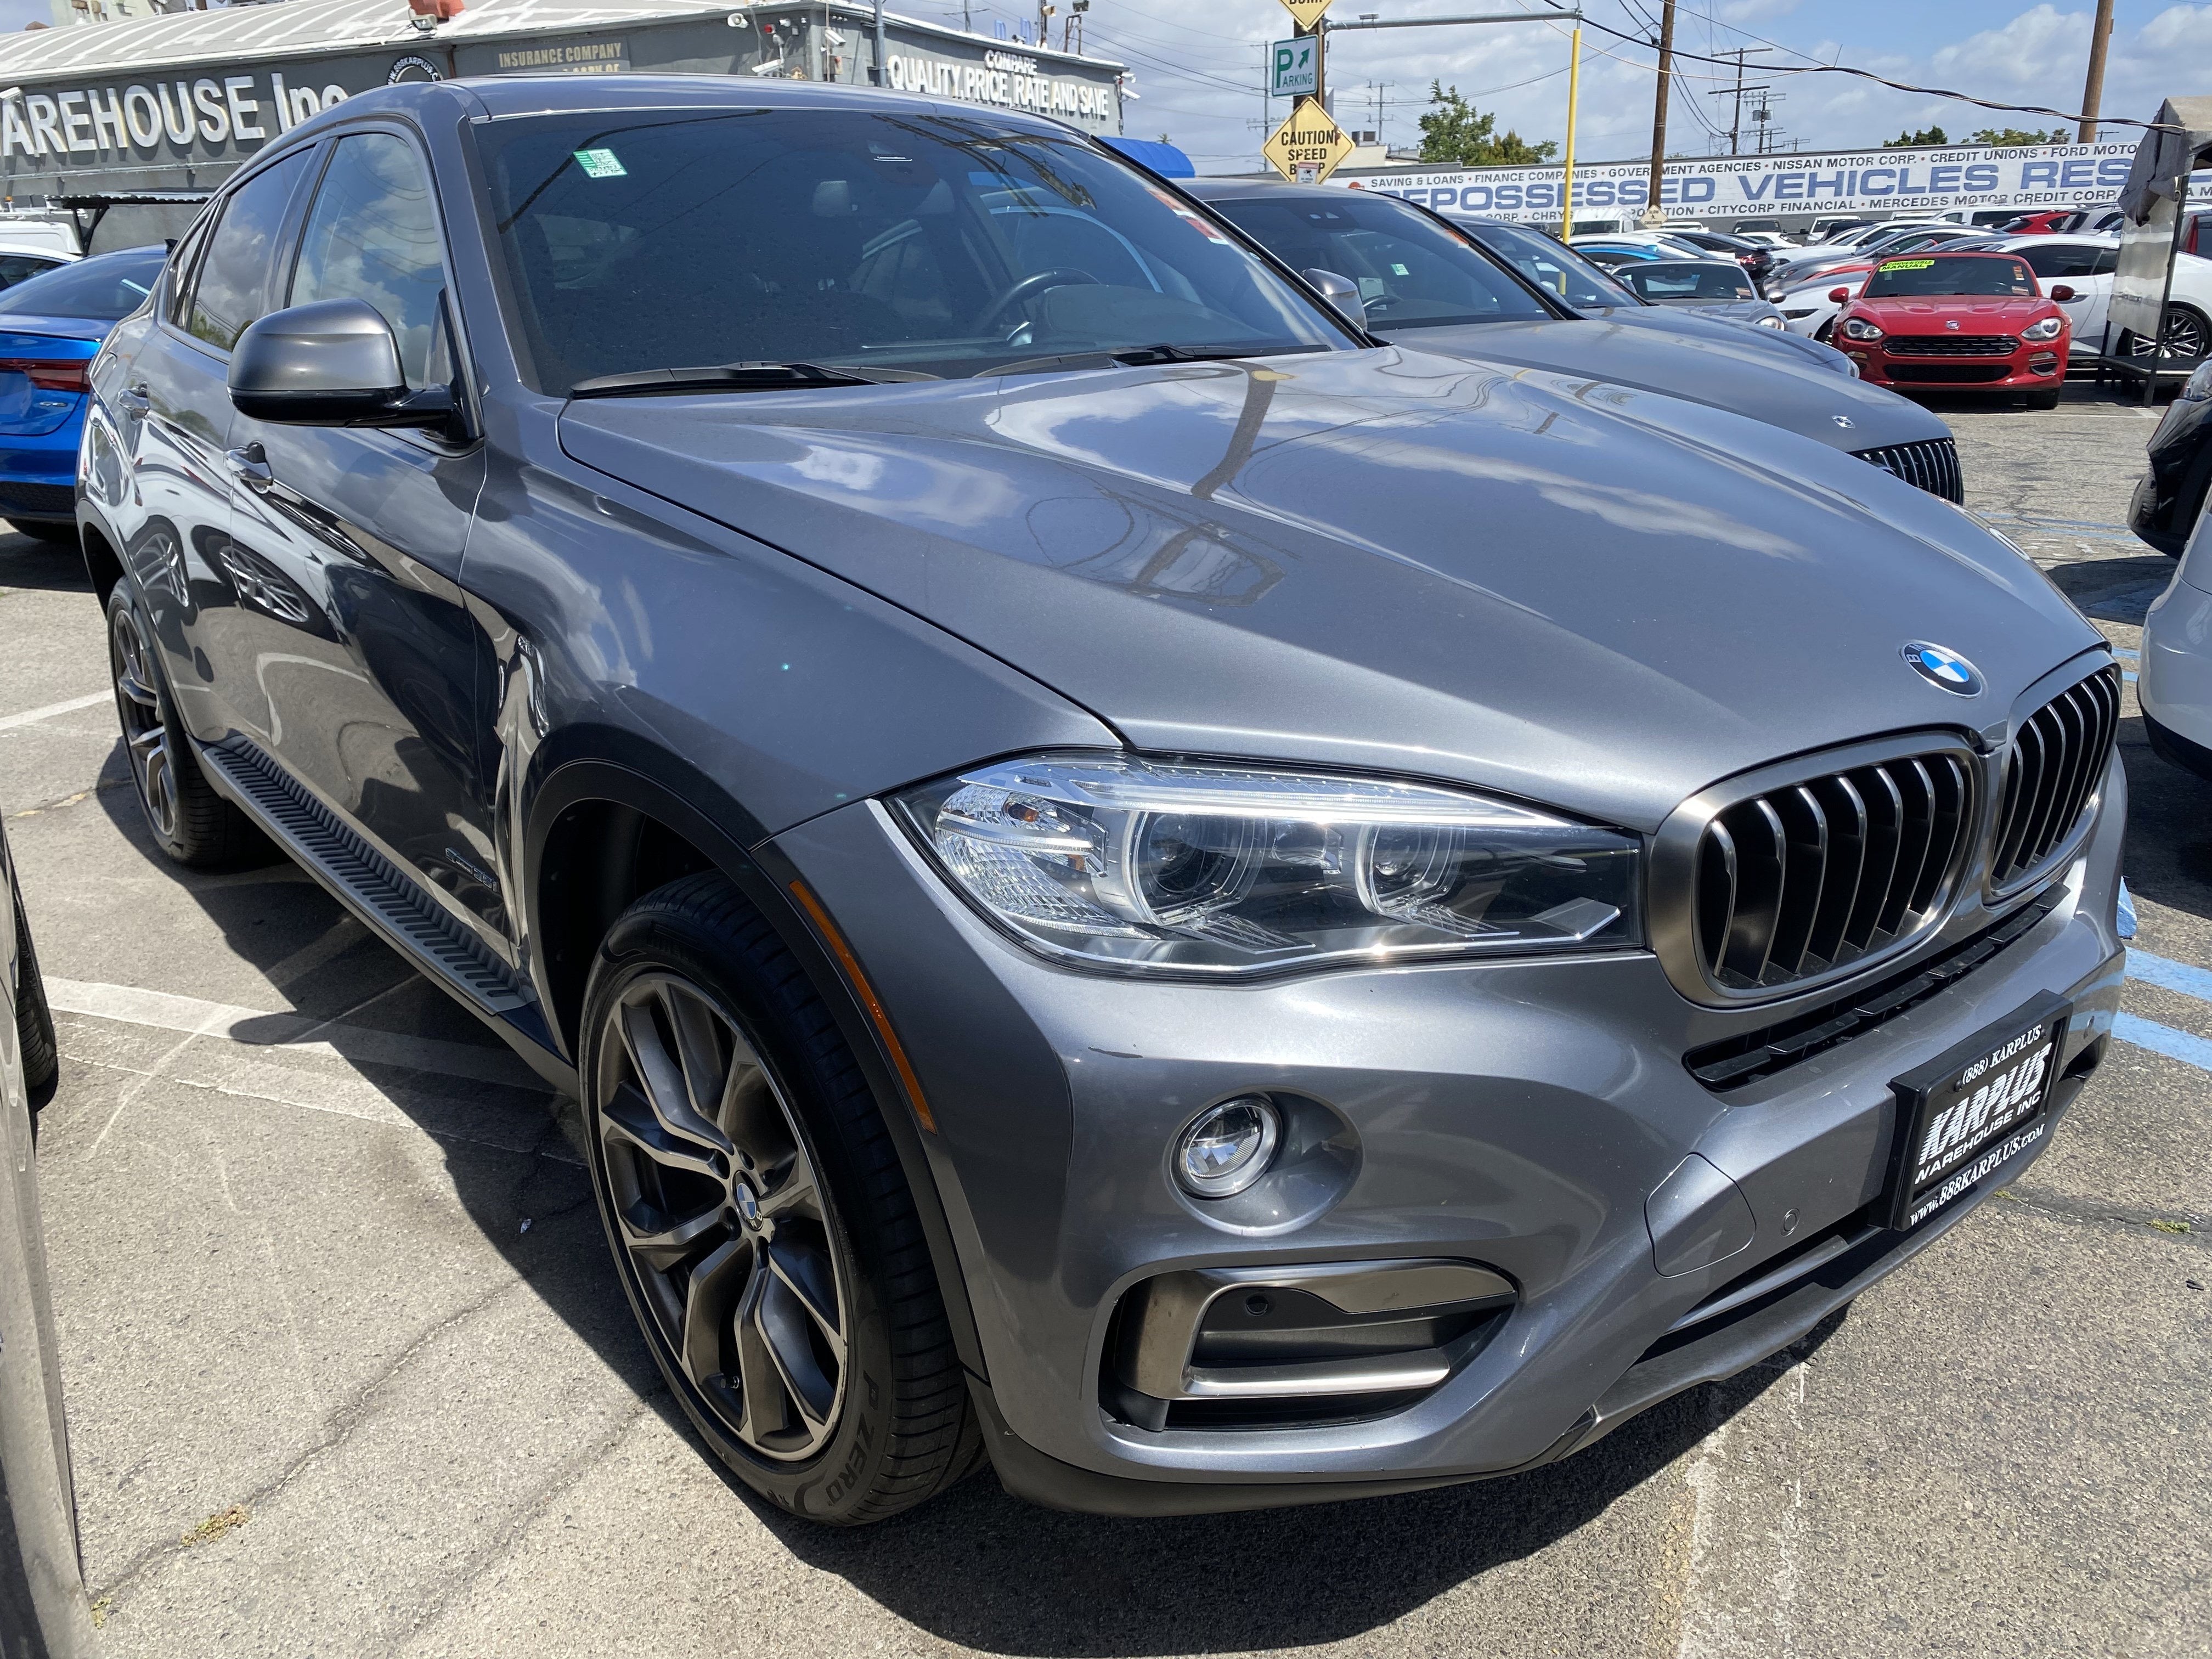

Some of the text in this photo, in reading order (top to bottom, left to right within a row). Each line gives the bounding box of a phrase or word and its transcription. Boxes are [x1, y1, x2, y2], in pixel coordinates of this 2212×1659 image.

[499, 43, 621, 67] INSURANCE COMPANY
[984, 49, 1037, 76] COMPARE
[1014, 75, 1049, 108] RATE
[1050, 81, 1079, 112] AND
[1078, 86, 1109, 116] SAVE
[1281, 130, 1334, 146] CAUTION
[1288, 148, 1327, 161] SPEED
[1290, 162, 1325, 175] BP
[1371, 177, 1412, 187] SAVING
[1427, 175, 1464, 185] LOANS
[1475, 173, 1524, 183] FINANCE
[1528, 170, 1597, 180] COMPNIES
[1609, 165, 1695, 177] GOVERMENT
[1699, 161, 1761, 173] AGENCIES
[1773, 158, 1822, 170] NISSAN
[1827, 156, 1874, 167] MOTOR
[1879, 154, 1917, 165] CORP.
[1931, 151, 1979, 162] CREDIT
[1984, 149, 2038, 160] UNIONS
[2051, 146, 2089, 157] FORD
[1377, 177, 1716, 212] EPOSSESSED
[1737, 164, 1999, 200] VEHICLES
[1708, 204, 1775, 215] CITYCORP
[1780, 200, 1856, 212] FINANCIAL
[1869, 196, 1949, 208] MERCEDES
[2014, 192, 2068, 205] CREDIT
[1962, 1024, 2041, 1085] (888) KARPLUS
[1918, 1042, 2052, 1165] KARPLUS
[1915, 1090, 2041, 1184] WAREHOUSE INC
[825, 1412, 874, 1506] ZERO
